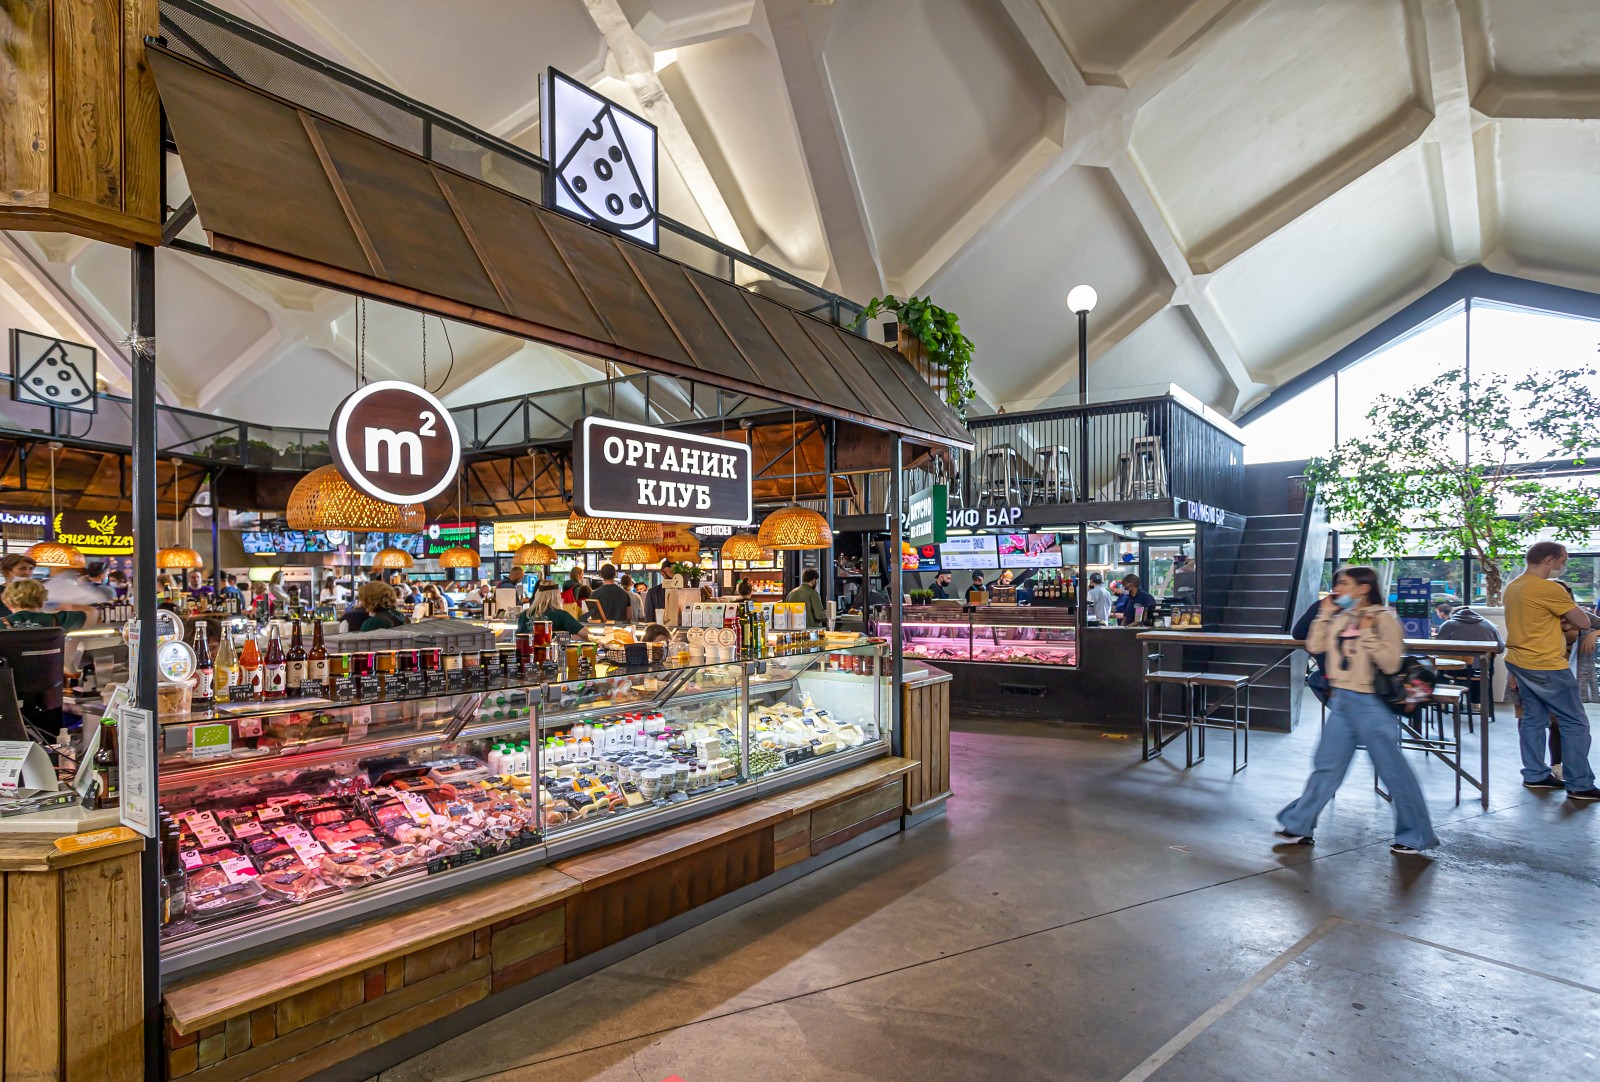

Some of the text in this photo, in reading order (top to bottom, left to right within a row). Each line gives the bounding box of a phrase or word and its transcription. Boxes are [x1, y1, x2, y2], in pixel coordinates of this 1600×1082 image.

[603, 436, 738, 479] ОРГАНИК
[637, 478, 711, 510] КЛУБ
[910, 496, 932, 522] ВКУСНО
[986, 506, 1022, 526] БАР
[58, 533, 112, 546] SHEMEN
[712, 526, 732, 536] KITCHEN
[530, 577, 537, 590] P
